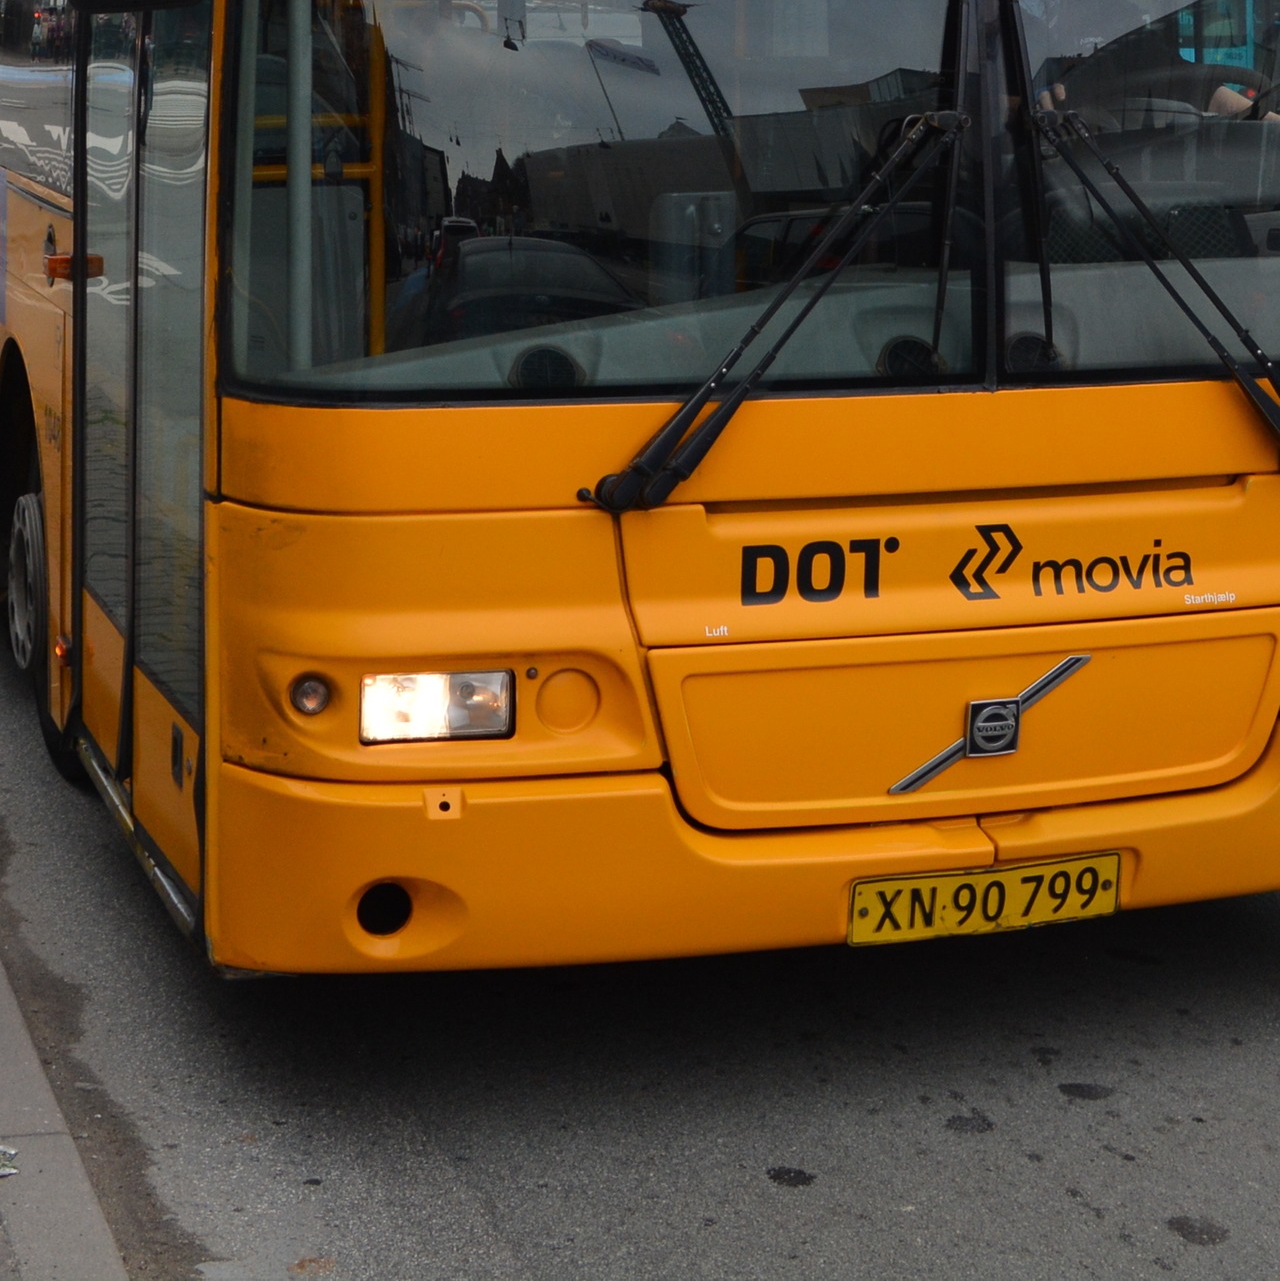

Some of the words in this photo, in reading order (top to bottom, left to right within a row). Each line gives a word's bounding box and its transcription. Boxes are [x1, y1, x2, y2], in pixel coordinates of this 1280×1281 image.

[740, 536, 900, 607] DOT
[1032, 539, 1194, 597] movia
[1184, 591, 1236, 605] Starthjælp
[705, 625, 729, 637] Luft
[975, 724, 1014, 733] VOLVO
[873, 886, 938, 933] XN
[952, 880, 1006, 927] 90
[1020, 866, 1100, 918] 799
